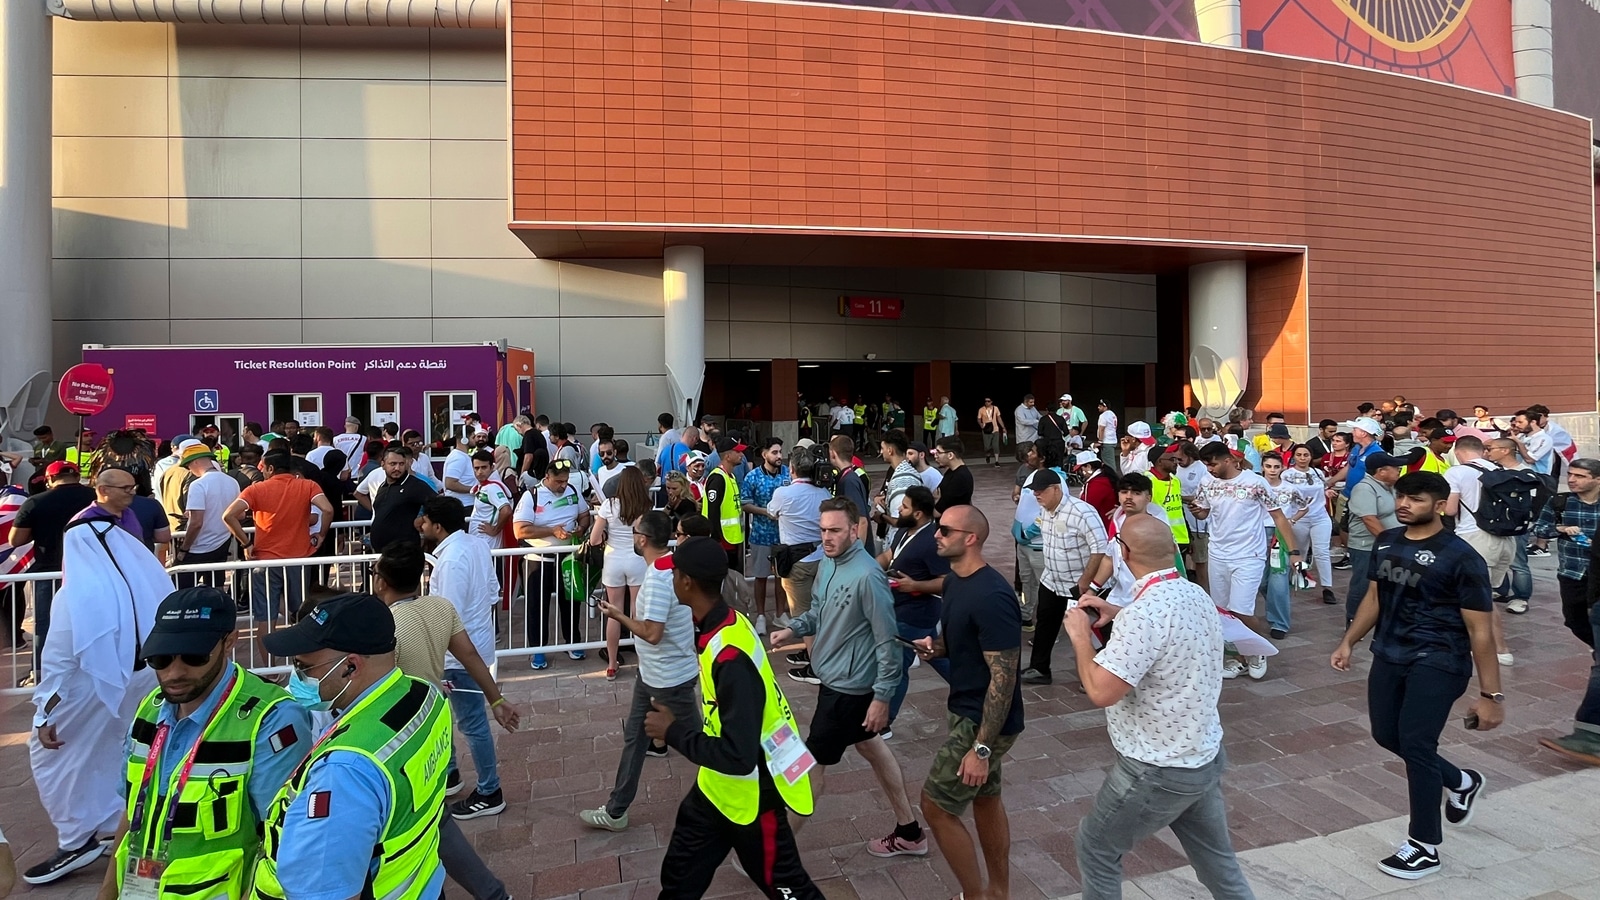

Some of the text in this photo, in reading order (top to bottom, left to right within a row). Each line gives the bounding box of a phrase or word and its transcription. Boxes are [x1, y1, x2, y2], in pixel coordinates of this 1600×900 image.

[869, 300, 881, 313] 11
[234, 360, 356, 369] Ticket Resolution Point
[364, 359, 447, 371] نقطة دعم التذاكر
[81, 382, 107, 392] Re-Entry
[74, 395, 99, 403] Stadium
[423, 726, 450, 787] AMBLANCE
